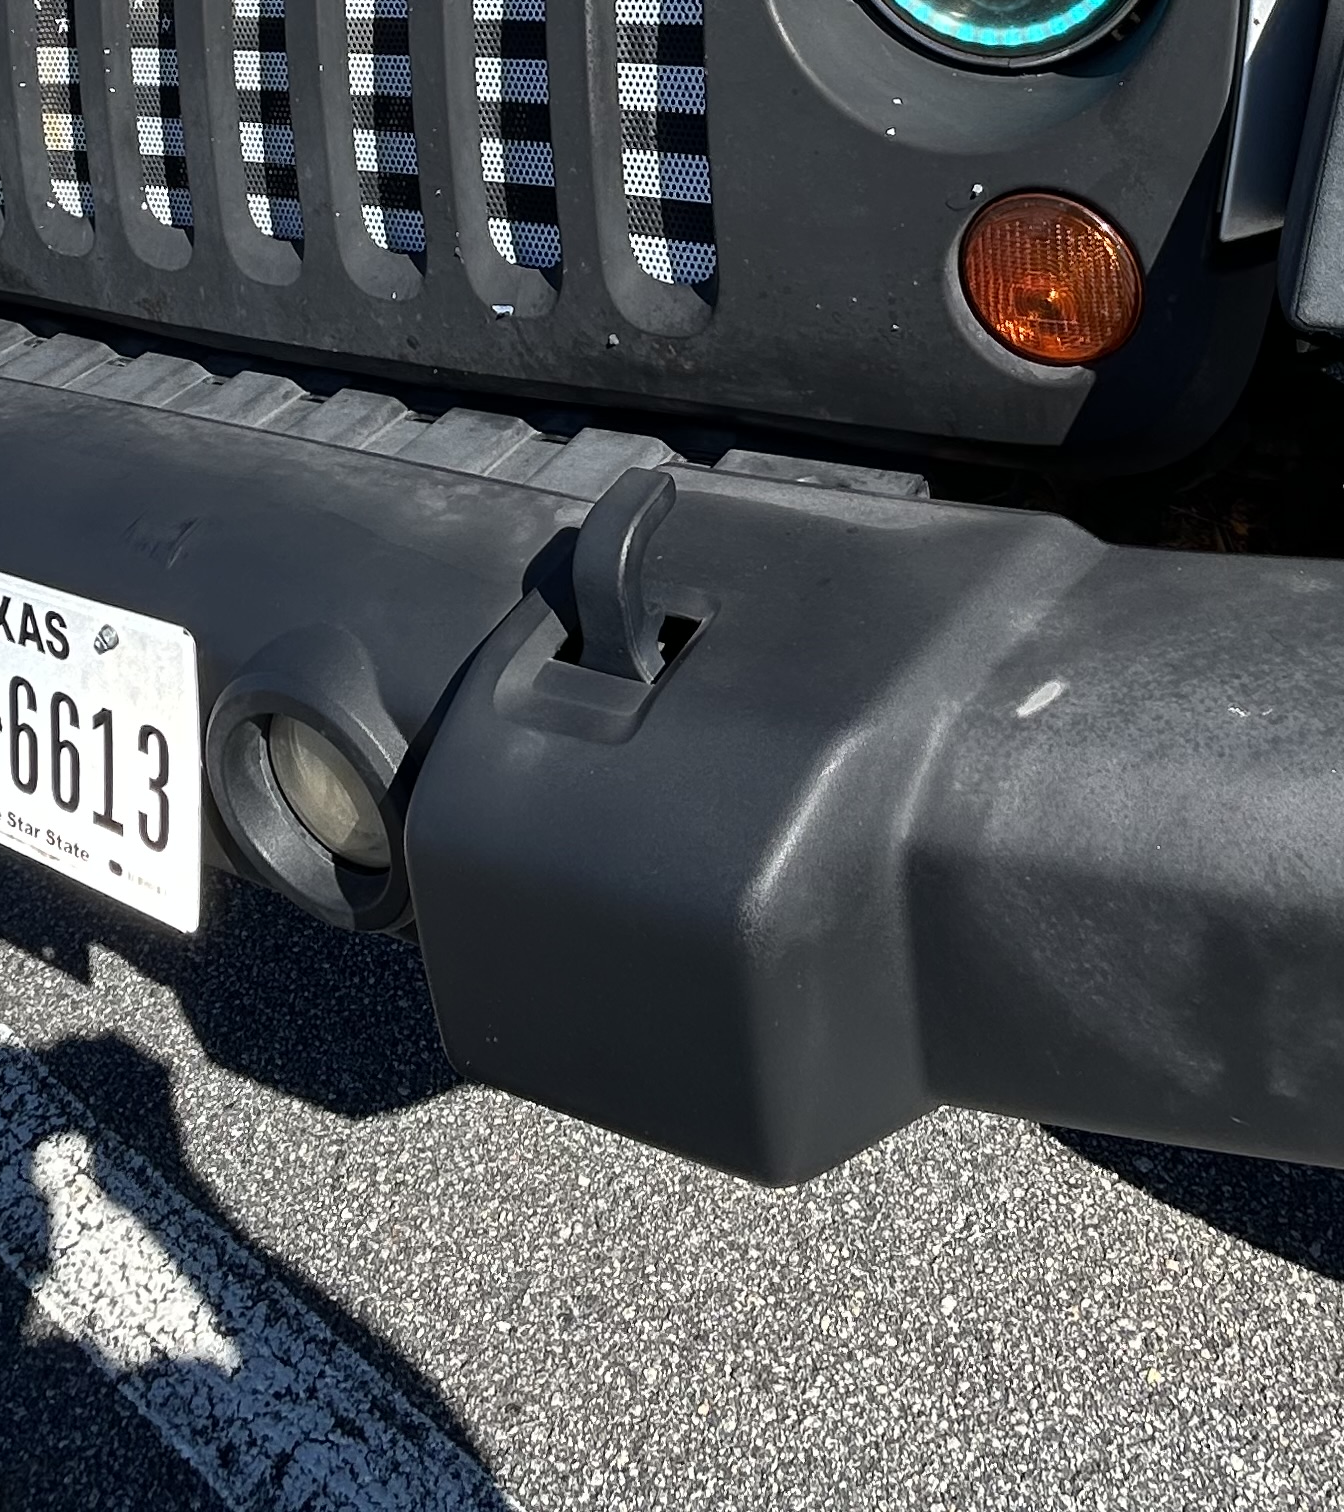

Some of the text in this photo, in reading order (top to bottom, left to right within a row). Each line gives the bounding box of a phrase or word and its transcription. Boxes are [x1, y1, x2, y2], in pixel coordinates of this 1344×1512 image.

[9, 675, 170, 852] 6613
[7, 811, 40, 839] Star
[46, 829, 90, 862] State
